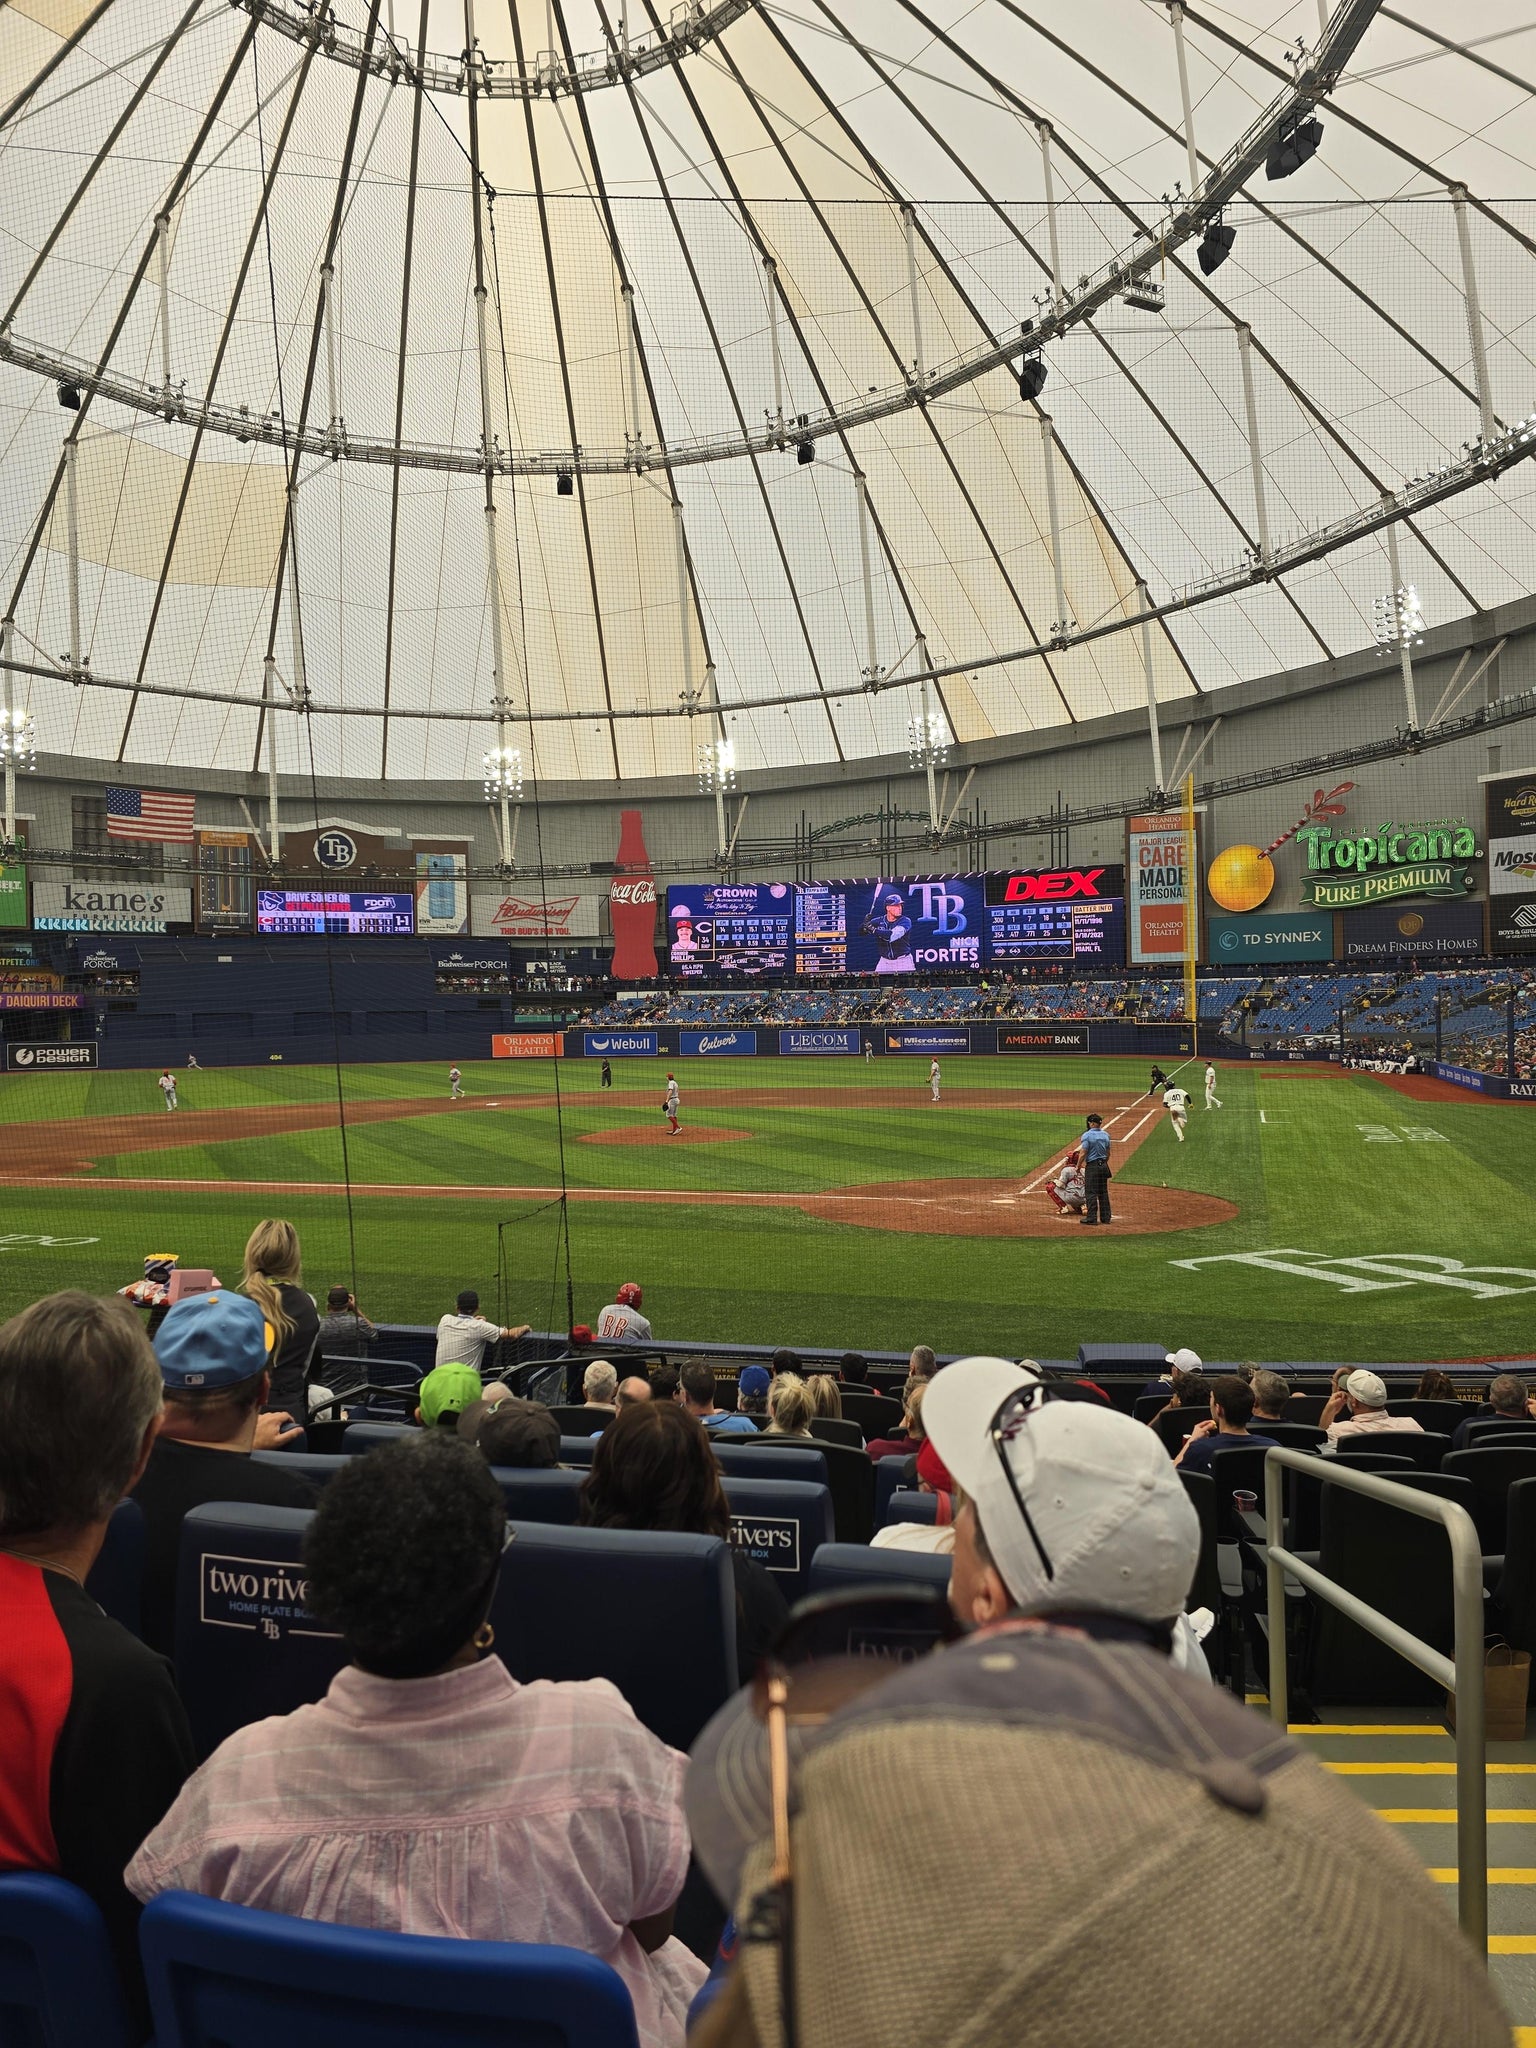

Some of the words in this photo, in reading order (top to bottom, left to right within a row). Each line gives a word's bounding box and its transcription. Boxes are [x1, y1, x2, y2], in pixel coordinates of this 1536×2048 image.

[1144, 816, 1182, 825] ORLANDO
[1148, 823, 1178, 831] HEALTH
[1139, 837, 1162, 847] MAJOR
[1162, 835, 1187, 845] LEAGUE
[321, 838, 350, 863] TB
[1296, 826, 1476, 872] Tropicana
[1139, 844, 1187, 868] CARE
[1139, 866, 1188, 888] MADE
[1004, 868, 1106, 902] DEX
[1314, 883, 1361, 903] PURE
[1364, 867, 1451, 898] PREMIUM
[62, 884, 165, 914] kane's
[611, 880, 657, 905] Coca-Cola
[713, 888, 758, 898] CROWN
[1139, 887, 1188, 900] PERSONAL
[500, 904, 571, 918] Budweiser
[908, 882, 968, 935] TB
[1075, 905, 1097, 913] BATTER
[73, 913, 156, 921] FURNITURE
[1145, 921, 1184, 930] ORLANDO
[1149, 928, 1180, 938] HEALTH
[1243, 933, 1262, 945] TD
[1264, 930, 1322, 945] SYNNEX
[951, 936, 980, 946] NICK
[1348, 942, 1388, 955] DREAM
[1389, 939, 1435, 953] FINDERS
[1436, 937, 1479, 951] HOMES
[914, 947, 979, 963] FORTES
[83, 960, 118, 969] PORCH
[438, 960, 475, 969] Budweiser
[474, 960, 508, 970] PORCH
[6, 995, 50, 1008] DAIQUIRI
[52, 995, 78, 1007] DECK
[503, 1036, 554, 1046] ORLANDO
[611, 1037, 650, 1050] Webull
[698, 1033, 738, 1054] Culver's
[1005, 1036, 1054, 1045] AMERANT
[1054, 1035, 1081, 1045] BANK
[36, 1048, 90, 1057] POWER
[509, 1046, 548, 1055] HEALTH
[36, 1055, 90, 1064] DESIGN
[1171, 1093, 1181, 1102] 40
[726, 1520, 792, 1548] rivers
[751, 1549, 769, 1558] BOX
[210, 1565, 259, 1597] two
[262, 1568, 312, 1602] rive
[229, 1600, 259, 1614] HOME
[261, 1603, 292, 1617] PLATE
[260, 1617, 281, 1640] TB
